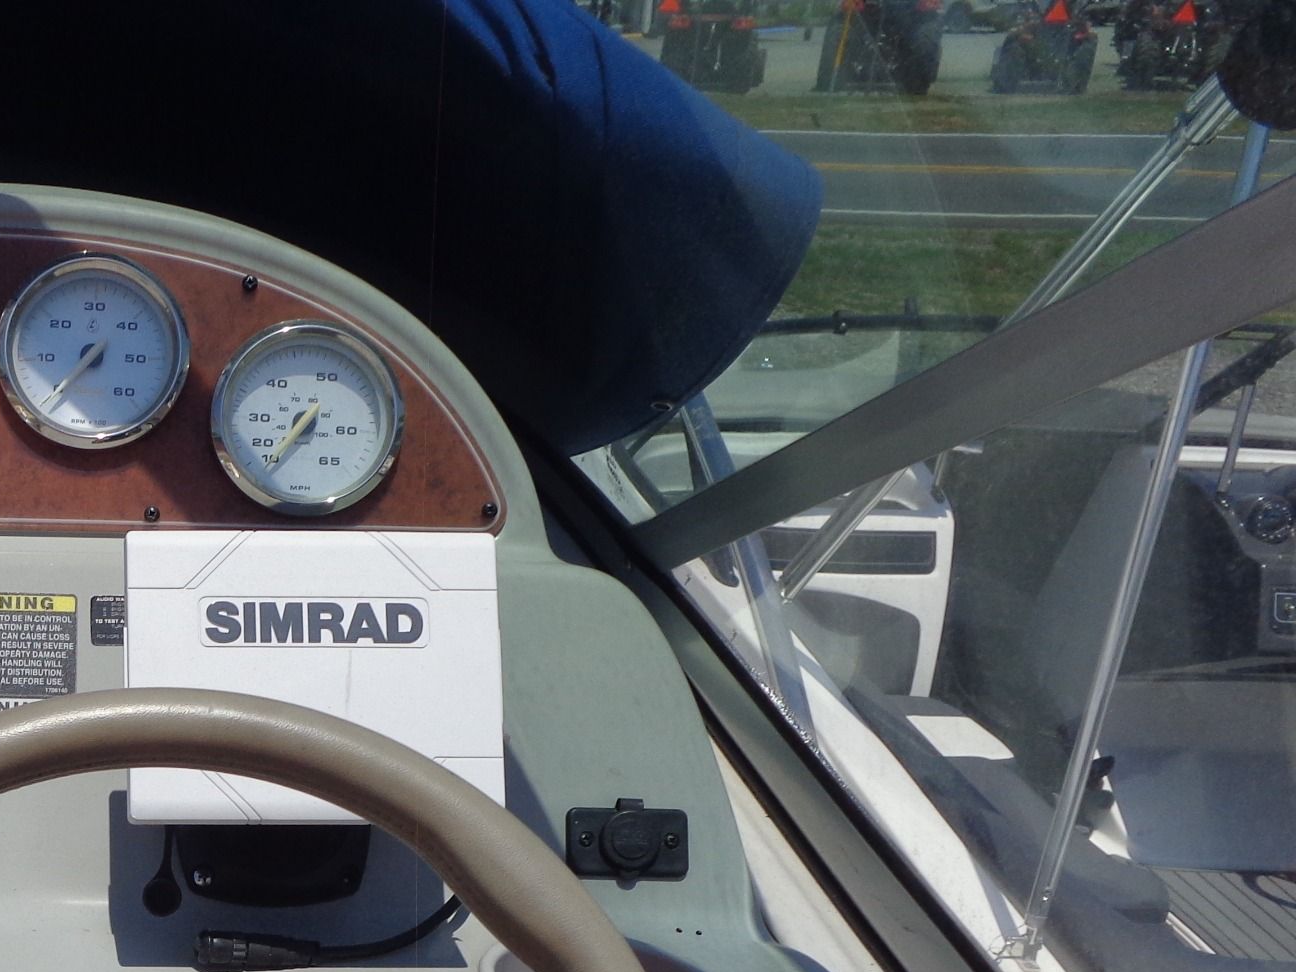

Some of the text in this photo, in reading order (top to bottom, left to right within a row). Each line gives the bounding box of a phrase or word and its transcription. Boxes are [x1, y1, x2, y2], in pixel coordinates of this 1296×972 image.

[84, 302, 106, 311] 30
[49, 319, 71, 329] 20
[116, 322, 138, 331] 40
[37, 353, 55, 362] 10
[124, 354, 146, 364] 50
[316, 372, 338, 382] 50
[266, 379, 288, 388] 40
[113, 387, 135, 397] 60
[248, 413, 270, 423] 30
[336, 426, 357, 436] 60
[252, 438, 274, 447] 20
[318, 457, 341, 466] 65
[34, 615, 73, 623] CONTROL
[205, 601, 424, 644] SIMRAD
[49, 624, 63, 632] UN-
[1, 632, 18, 640] CAN
[49, 633, 70, 641] LOSS
[1, 641, 32, 649] RESULT
[43, 642, 74, 650] SEVERE
[32, 651, 69, 659] DAMAGE.
[1, 659, 42, 667] HANDLING
[44, 660, 63, 668] WILL
[12, 677, 45, 685] BEFORE
[46, 678, 65, 686] USE.
